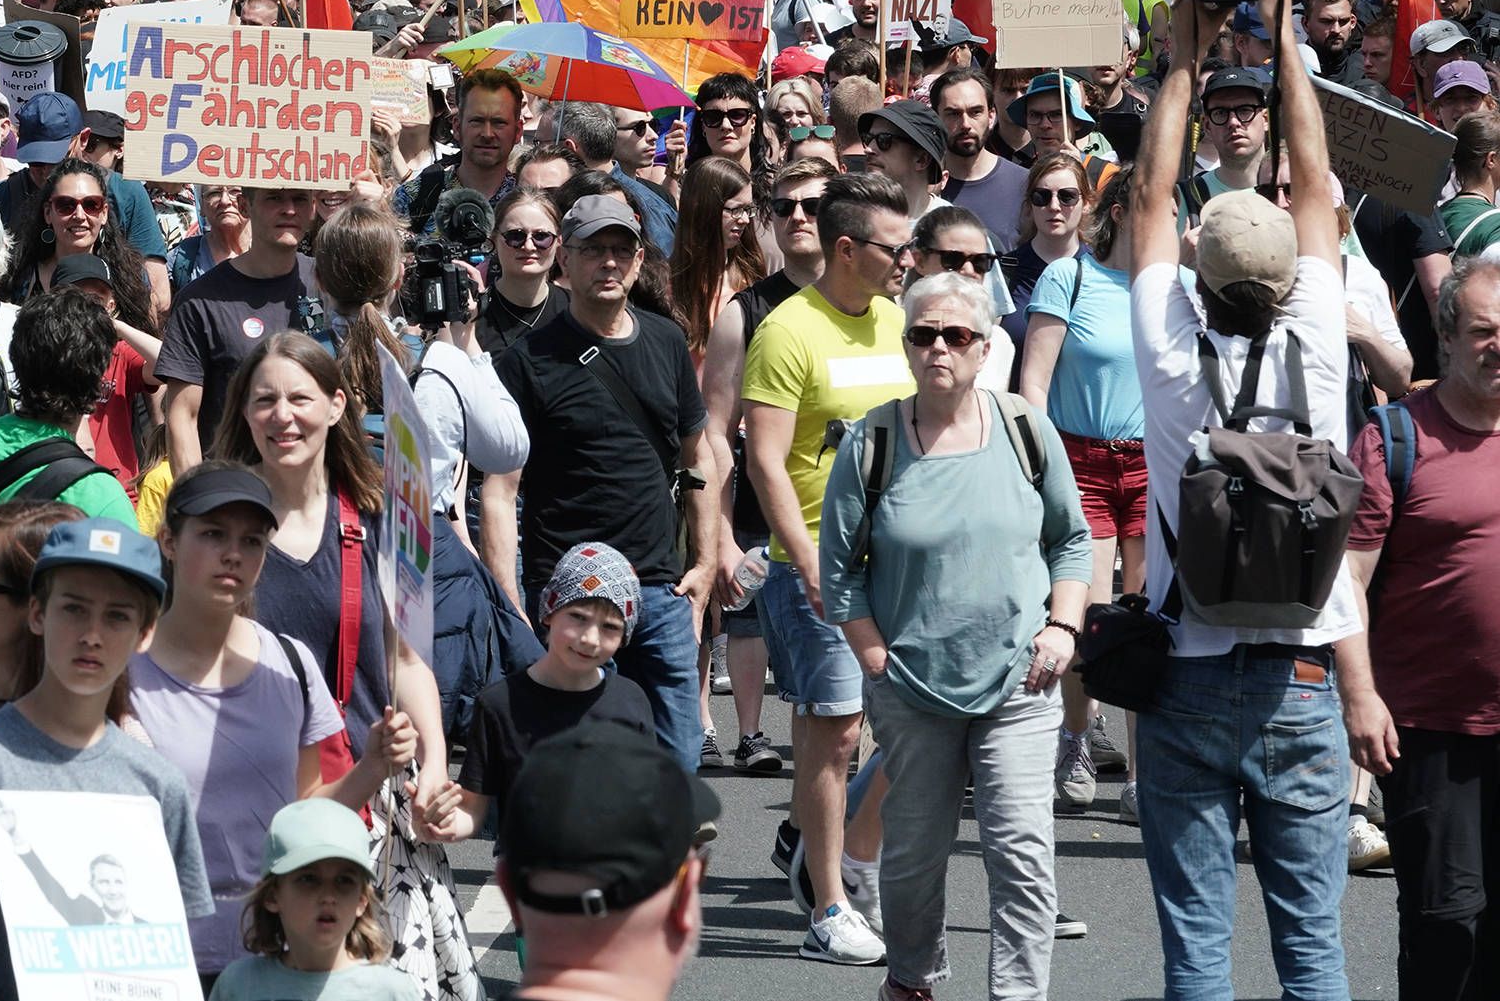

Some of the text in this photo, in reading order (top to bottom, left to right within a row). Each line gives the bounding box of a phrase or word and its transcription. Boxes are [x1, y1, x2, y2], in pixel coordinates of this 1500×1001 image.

[636, 0, 763, 31] KEIN IST
[12, 70, 38, 79] AFD?
[129, 27, 371, 92] Arschlöcher
[3, 78, 47, 91] hier rein!
[125, 83, 364, 137] geFährden
[1325, 94, 1388, 134] EGEN
[161, 132, 369, 183] Deutschland
[1325, 120, 1389, 162] AZIS
[1340, 157, 1414, 195] MAN NOCH
[16, 924, 188, 969] NIE WIEDER!
[94, 979, 164, 999] KEINE BÜHNE
